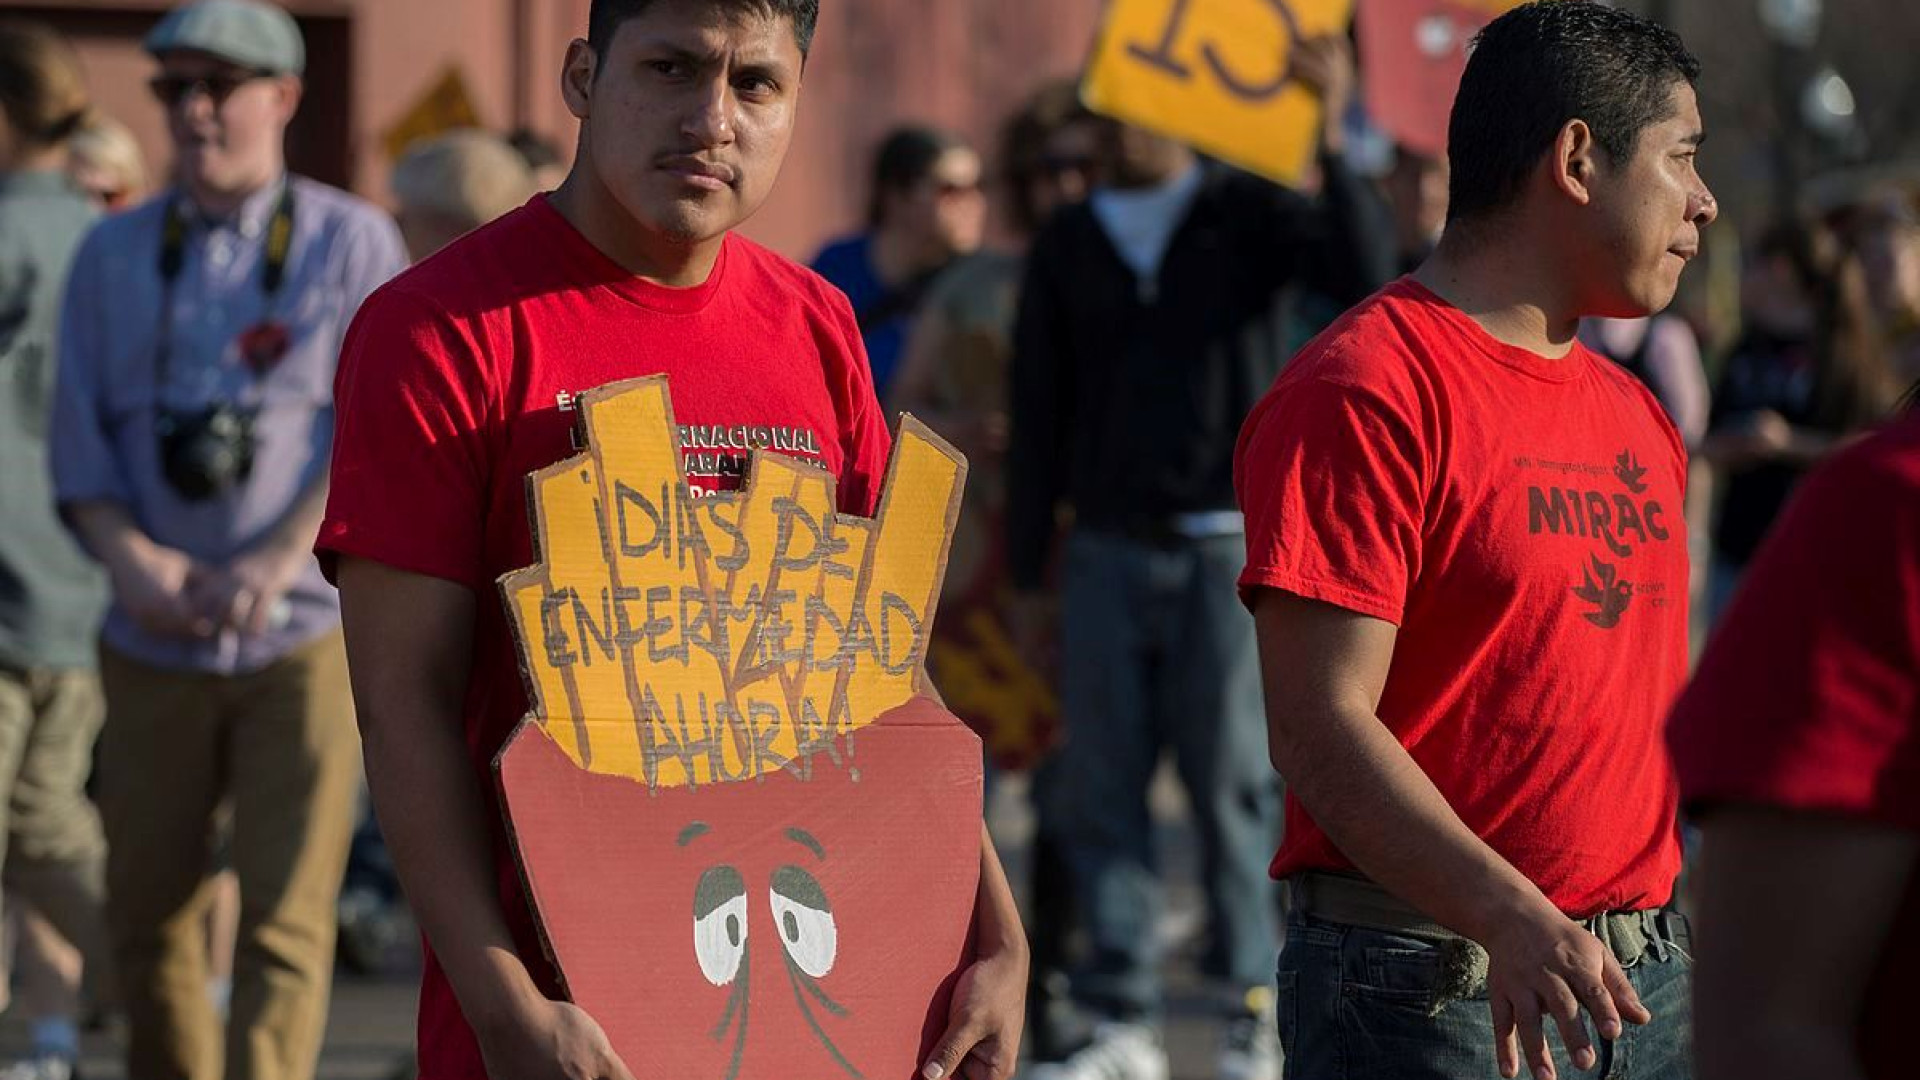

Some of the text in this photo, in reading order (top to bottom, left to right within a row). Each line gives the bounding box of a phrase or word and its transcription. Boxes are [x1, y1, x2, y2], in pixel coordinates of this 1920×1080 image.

[771, 496, 855, 581] DE
[1527, 486, 1669, 558] MIRAC
[540, 582, 923, 677] ENFERMEDAD
[641, 682, 862, 798] AHORA!
